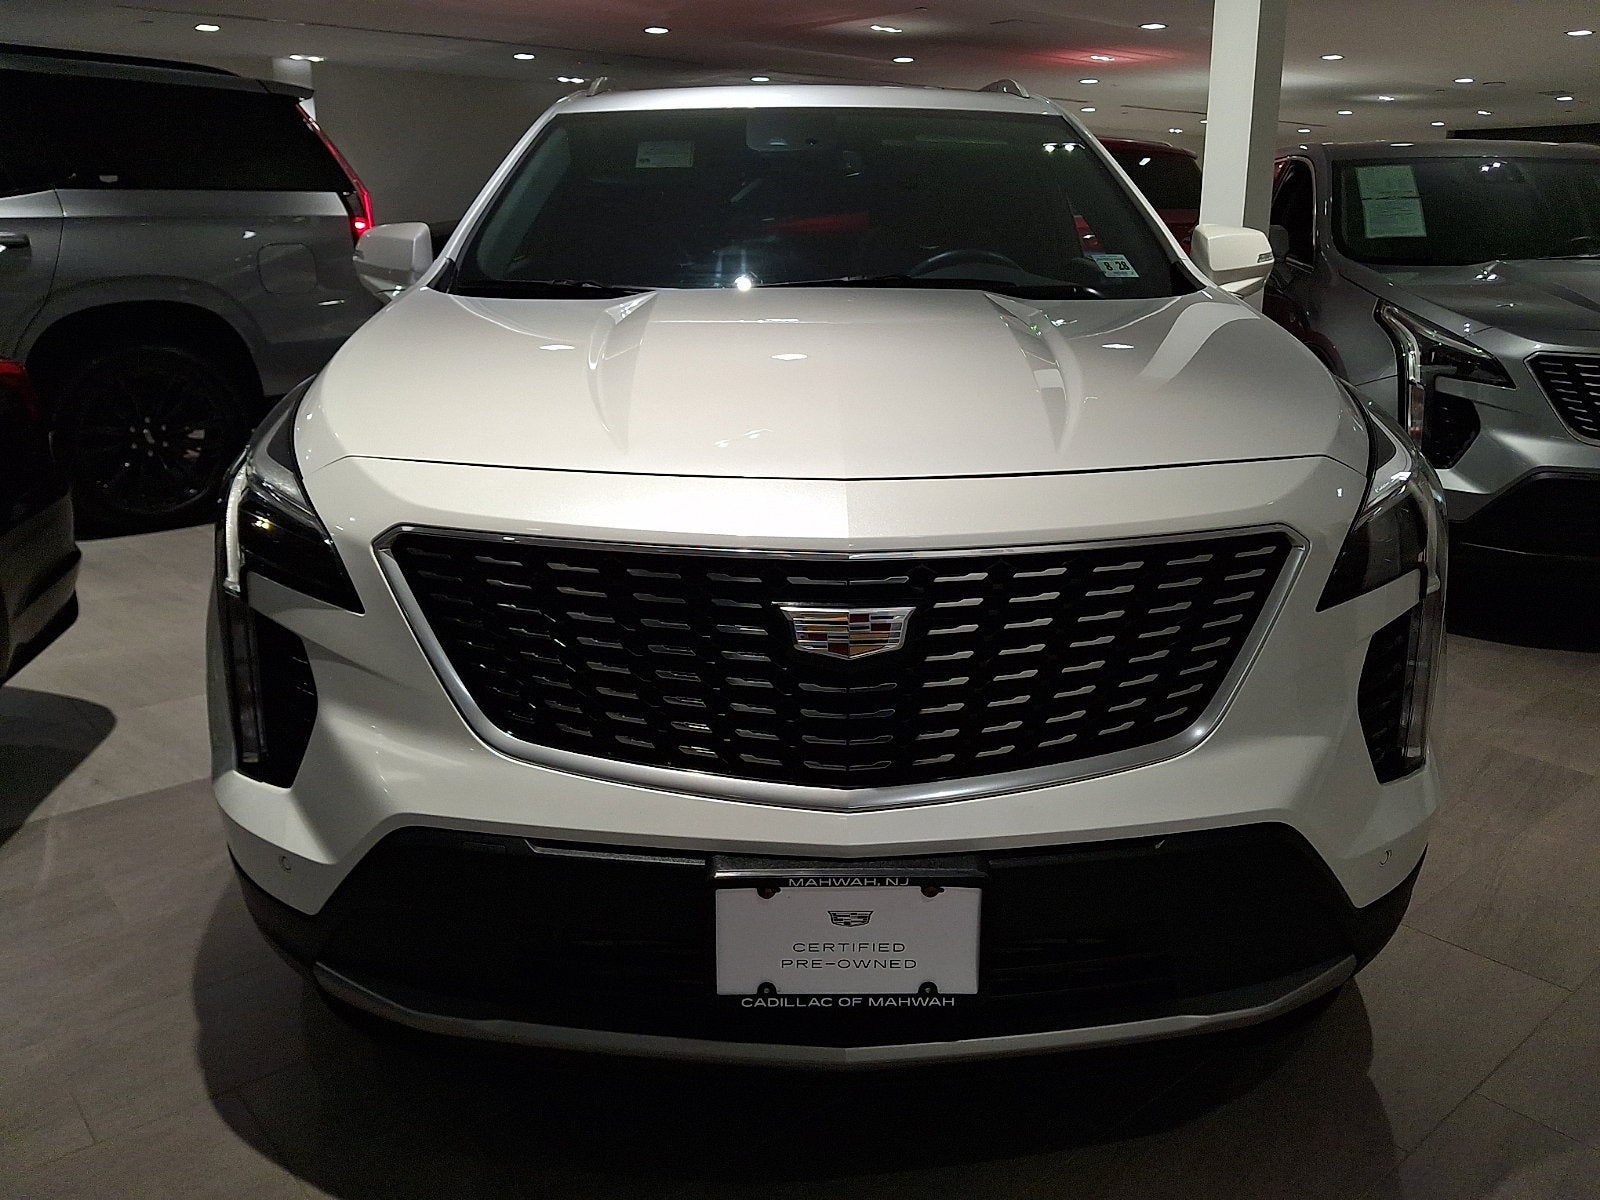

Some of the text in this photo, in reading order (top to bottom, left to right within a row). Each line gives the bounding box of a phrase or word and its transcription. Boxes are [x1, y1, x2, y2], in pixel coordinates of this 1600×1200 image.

[789, 877, 909, 887] MAHWAH, NJ
[792, 942, 906, 953] CERTIFIED
[781, 959, 917, 969] PRE-OWNED
[741, 997, 955, 1008] CADILLAC OF MAHWAH
